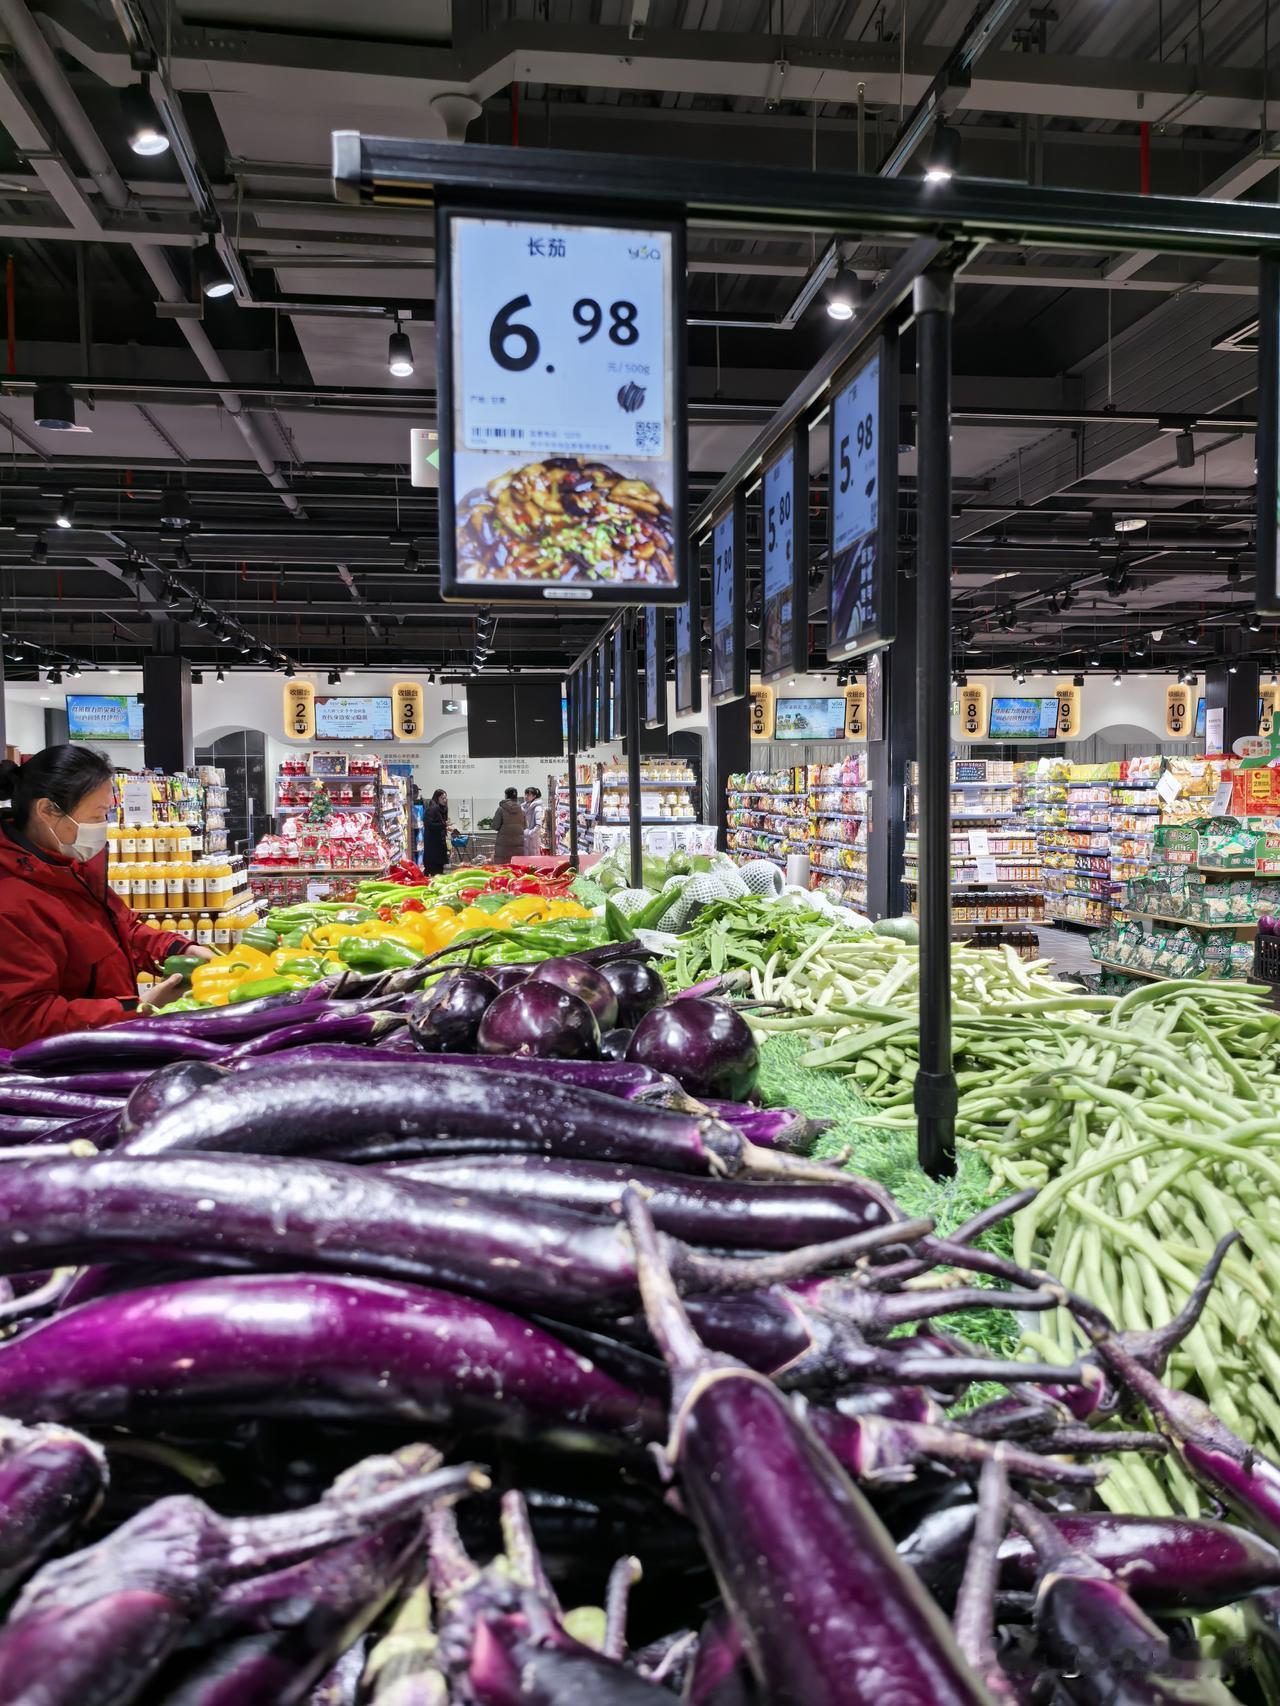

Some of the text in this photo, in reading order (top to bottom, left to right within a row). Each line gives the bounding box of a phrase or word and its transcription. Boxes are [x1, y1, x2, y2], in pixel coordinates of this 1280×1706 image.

[528, 237, 566, 258] 长茄
[397, 689, 419, 697] 收银台
[295, 703, 306, 718] 2
[403, 703, 414, 718] 3
[754, 704, 764, 718] 6
[850, 704, 860, 718] 7
[967, 703, 977, 717] 8
[1061, 703, 1071, 717] 9
[1168, 703, 1186, 717] 10
